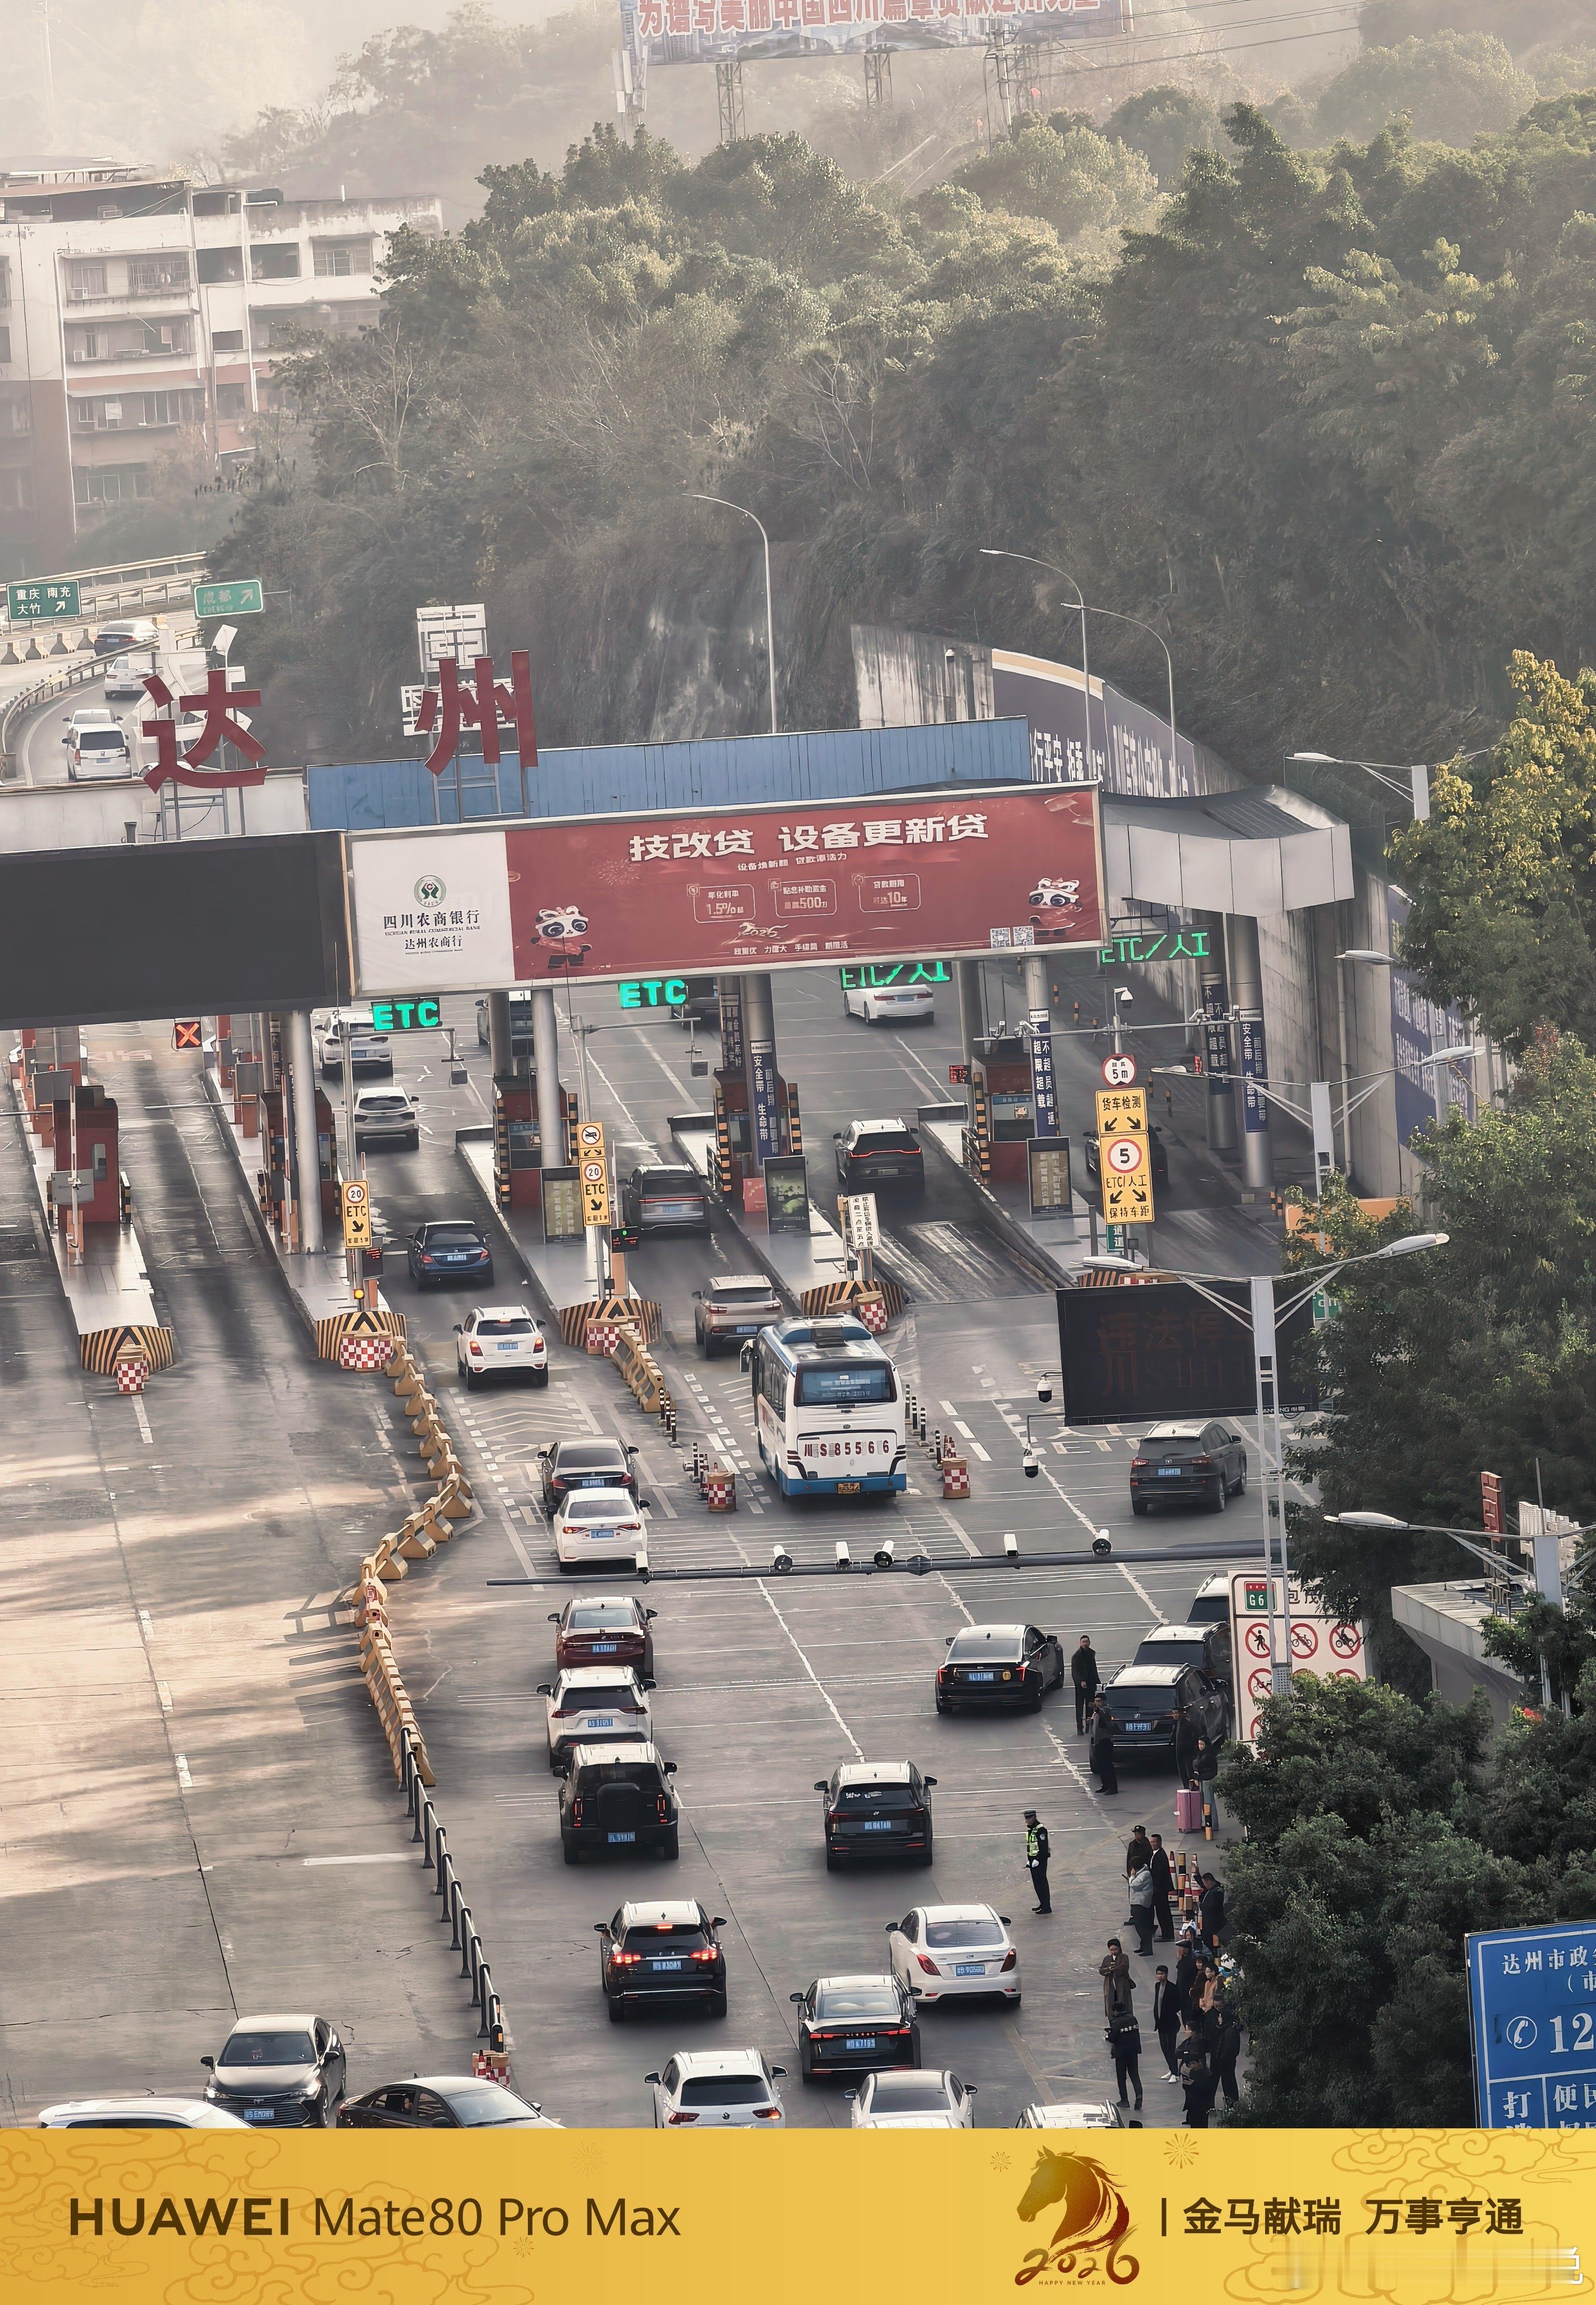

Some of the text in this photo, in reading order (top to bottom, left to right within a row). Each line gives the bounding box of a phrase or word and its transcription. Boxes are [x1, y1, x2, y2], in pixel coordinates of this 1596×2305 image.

[16, 585, 71, 600] 重庆 南充
[17, 603, 41, 615] 大竹
[629, 814, 989, 862] 技改贷 设备更新贷
[384, 910, 480, 929] 四川农商银行
[405, 935, 463, 950] 达州农商行
[620, 980, 686, 1007] ETC
[373, 1002, 439, 1030] ETC
[1102, 1095, 1141, 1111] 货车检测
[1120, 1148, 1130, 1164] 5
[589, 1167, 599, 1177] 20
[1106, 1174, 1148, 1189] ETC/人工
[351, 1190, 362, 1198] 20
[585, 1183, 605, 1196] ETC
[347, 1206, 367, 1217] ETC
[1109, 1205, 1150, 1218] 保持车距
[1502, 1945, 1596, 1975] 达州市政
